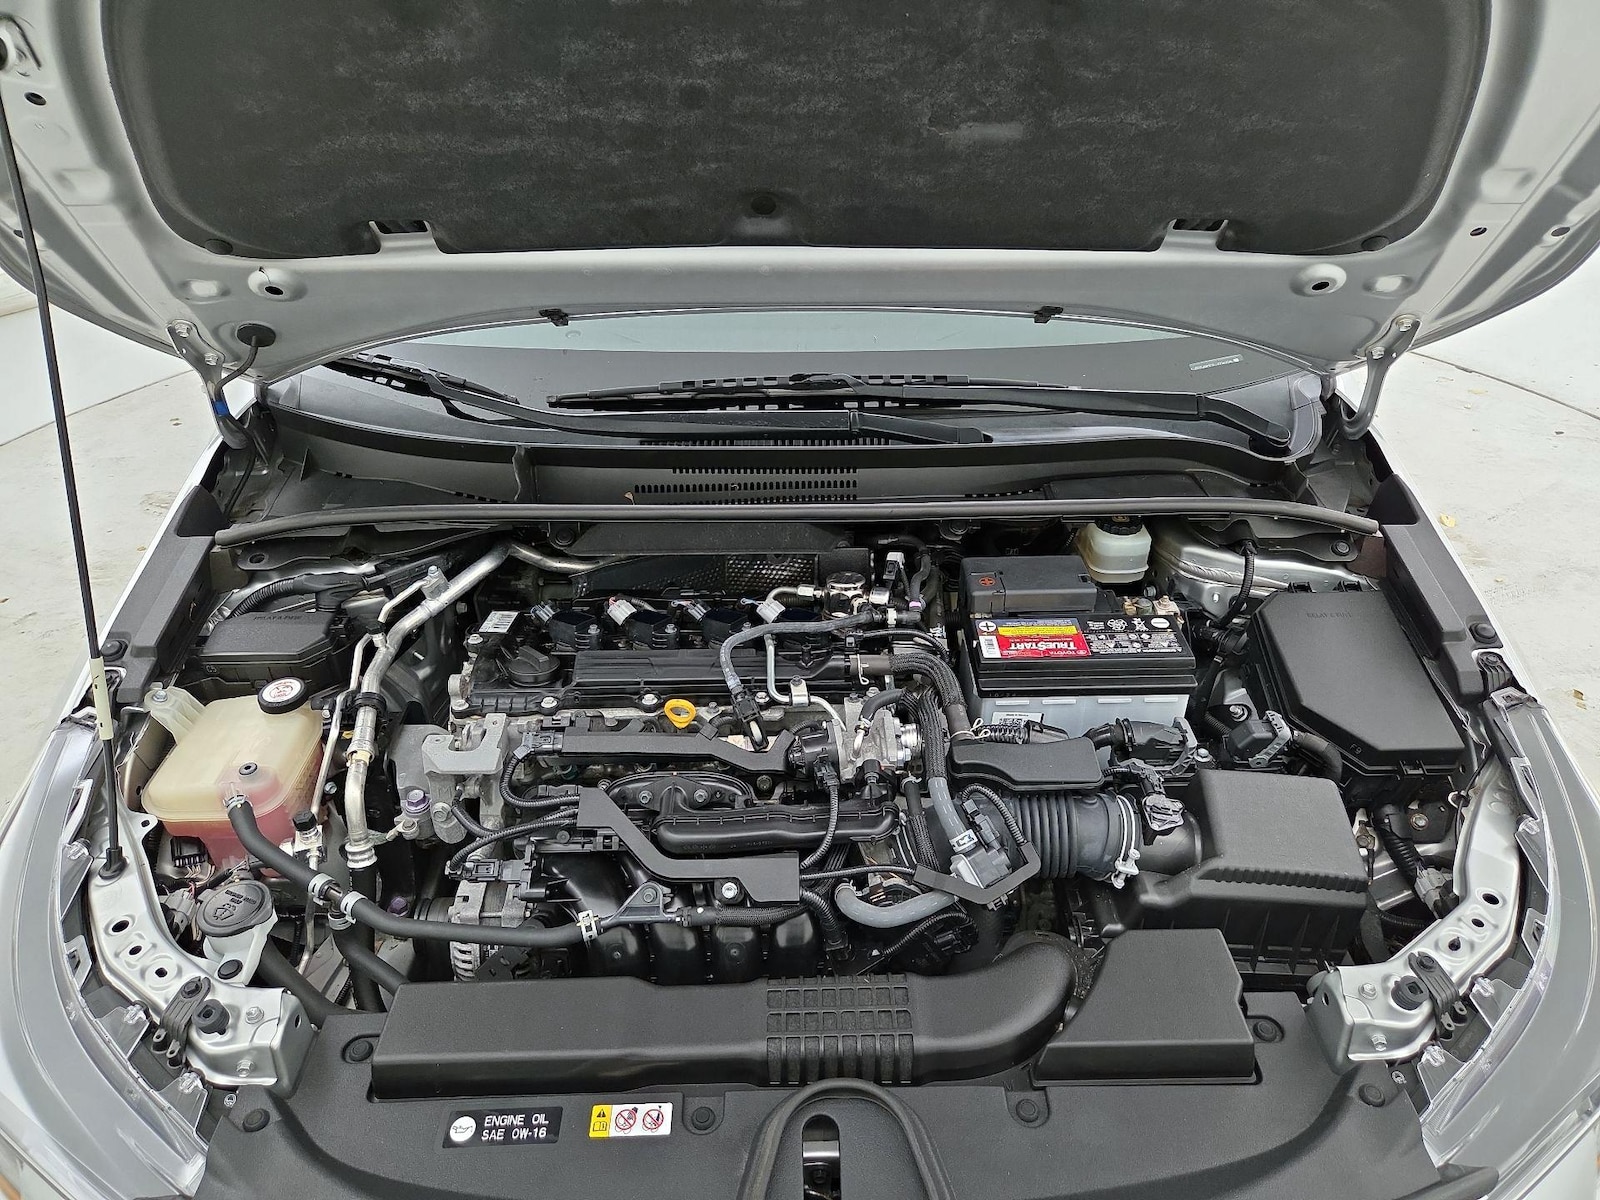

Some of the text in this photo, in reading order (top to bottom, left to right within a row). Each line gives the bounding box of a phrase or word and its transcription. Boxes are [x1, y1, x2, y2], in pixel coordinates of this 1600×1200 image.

[1009, 641, 1076, 650] TRUESTART
[484, 1113, 549, 1127] ENGINE OIL
[481, 1126, 547, 1141] SAE 0W-16
